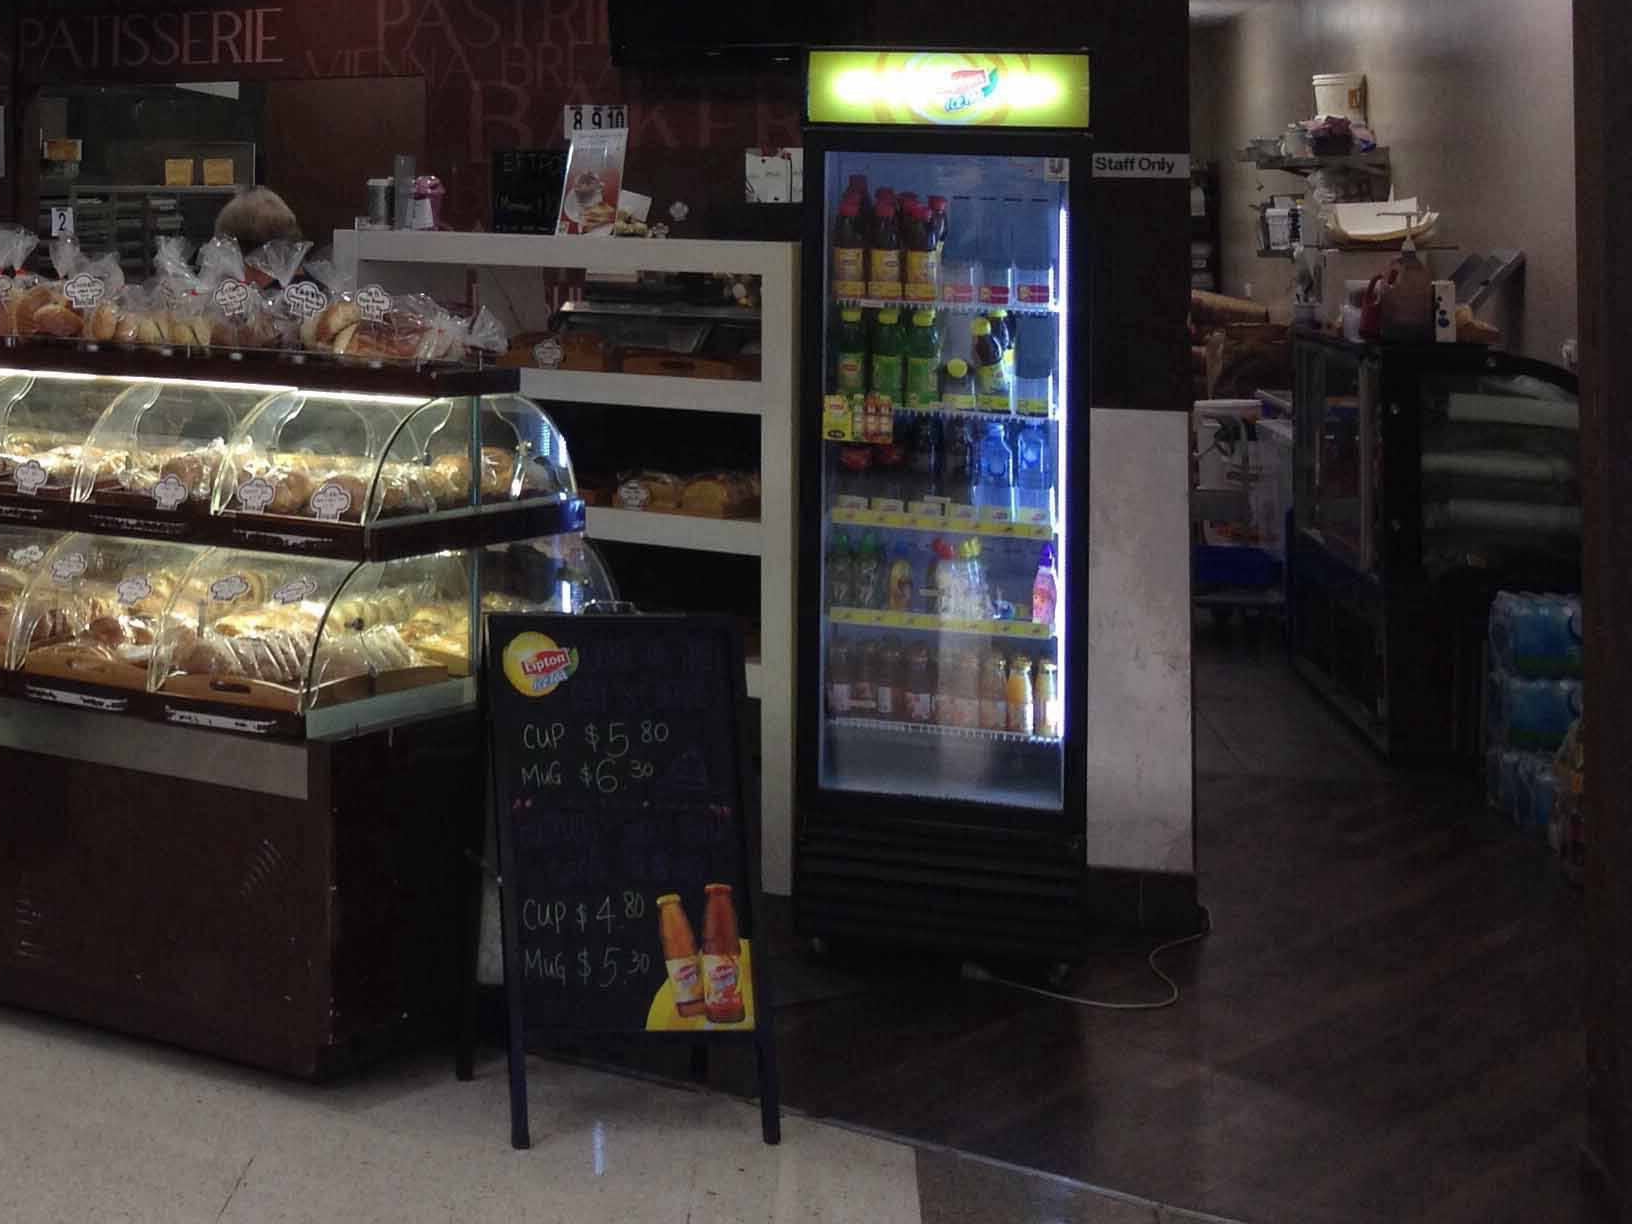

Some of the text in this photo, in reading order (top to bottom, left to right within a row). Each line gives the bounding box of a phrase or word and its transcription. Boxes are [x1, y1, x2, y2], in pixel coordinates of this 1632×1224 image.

[18, 6, 284, 70] PATISSERIE
[1095, 157, 1175, 174] Staff Only
[521, 652, 567, 675] Lipton
